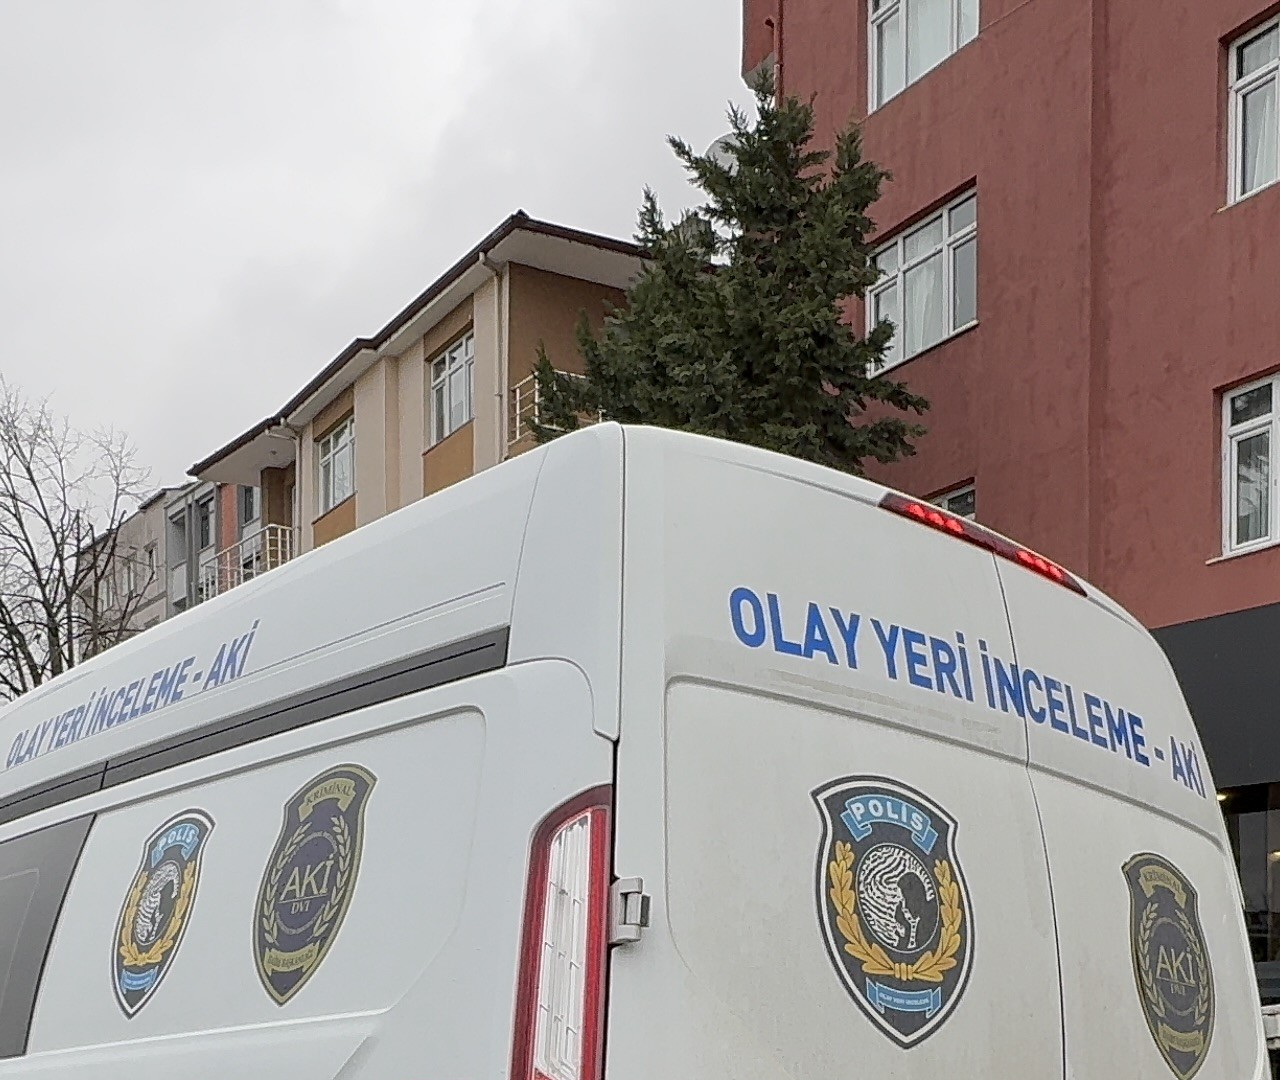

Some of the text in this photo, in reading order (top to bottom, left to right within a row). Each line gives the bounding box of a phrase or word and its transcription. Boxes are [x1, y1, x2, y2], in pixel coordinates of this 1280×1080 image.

[6, 717, 55, 769] OLAY
[48, 691, 98, 752] YERİ
[85, 655, 197, 737] İNCELEME
[202, 618, 261, 691] AKİ
[729, 586, 860, 669] OLAY
[870, 617, 974, 702] YERİ
[978, 638, 1151, 767] İNCELEME
[1170, 734, 1207, 800] AKİ
[280, 853, 335, 901] AKİ
[1155, 945, 1196, 985] AKİ
